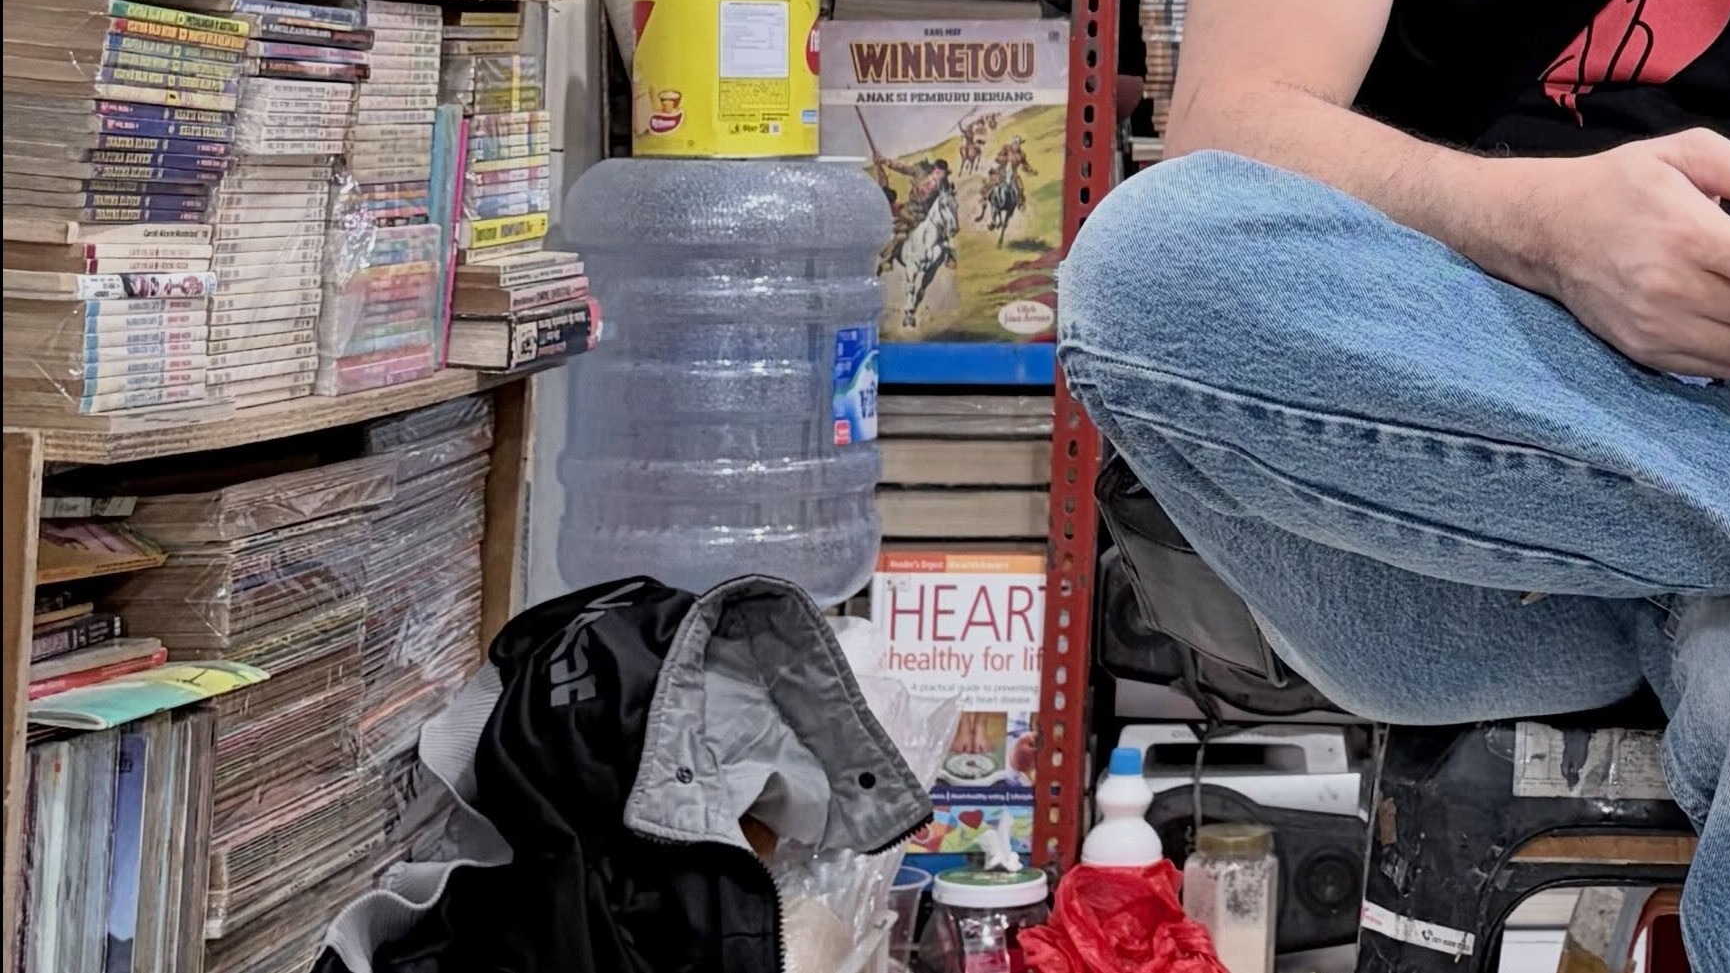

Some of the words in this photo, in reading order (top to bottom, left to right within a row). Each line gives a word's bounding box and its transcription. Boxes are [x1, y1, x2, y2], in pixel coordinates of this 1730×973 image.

[851, 41, 1036, 84] WINNETOU
[856, 92, 895, 103] ANAK
[897, 92, 908, 103] SI
[910, 92, 970, 103] PEMBURU
[973, 92, 1034, 103] BERUANG
[889, 645, 974, 677] healthy
[983, 645, 1014, 671] for
[1023, 646, 1044, 671] lif
